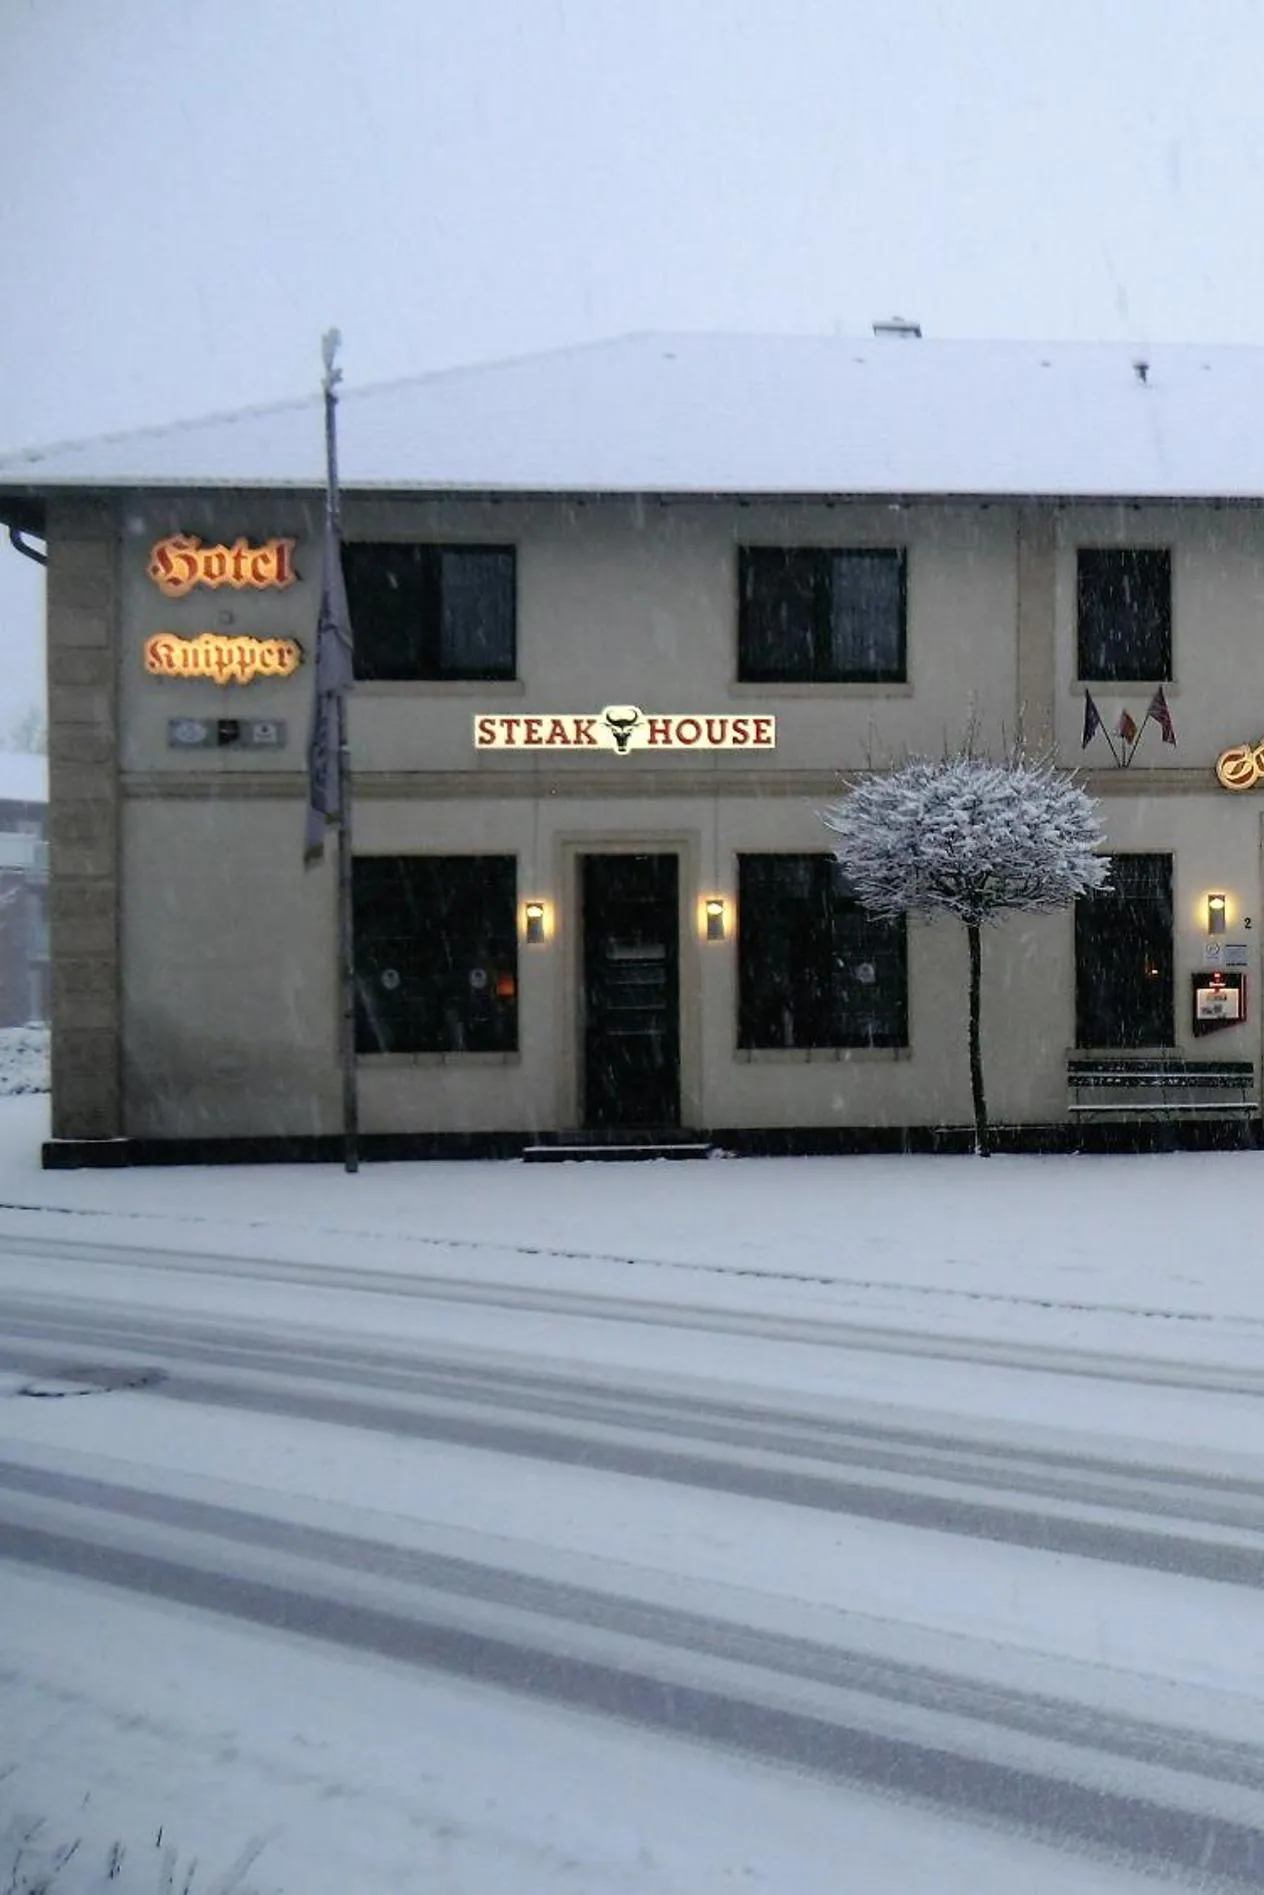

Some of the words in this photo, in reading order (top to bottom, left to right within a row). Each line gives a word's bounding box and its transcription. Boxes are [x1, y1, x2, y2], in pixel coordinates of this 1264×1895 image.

[150, 539, 292, 587] Hotel
[147, 639, 295, 678] Knipper
[478, 718, 598, 746] STEAK
[647, 718, 773, 746] HOUSE
[1243, 917, 1253, 929] 2
